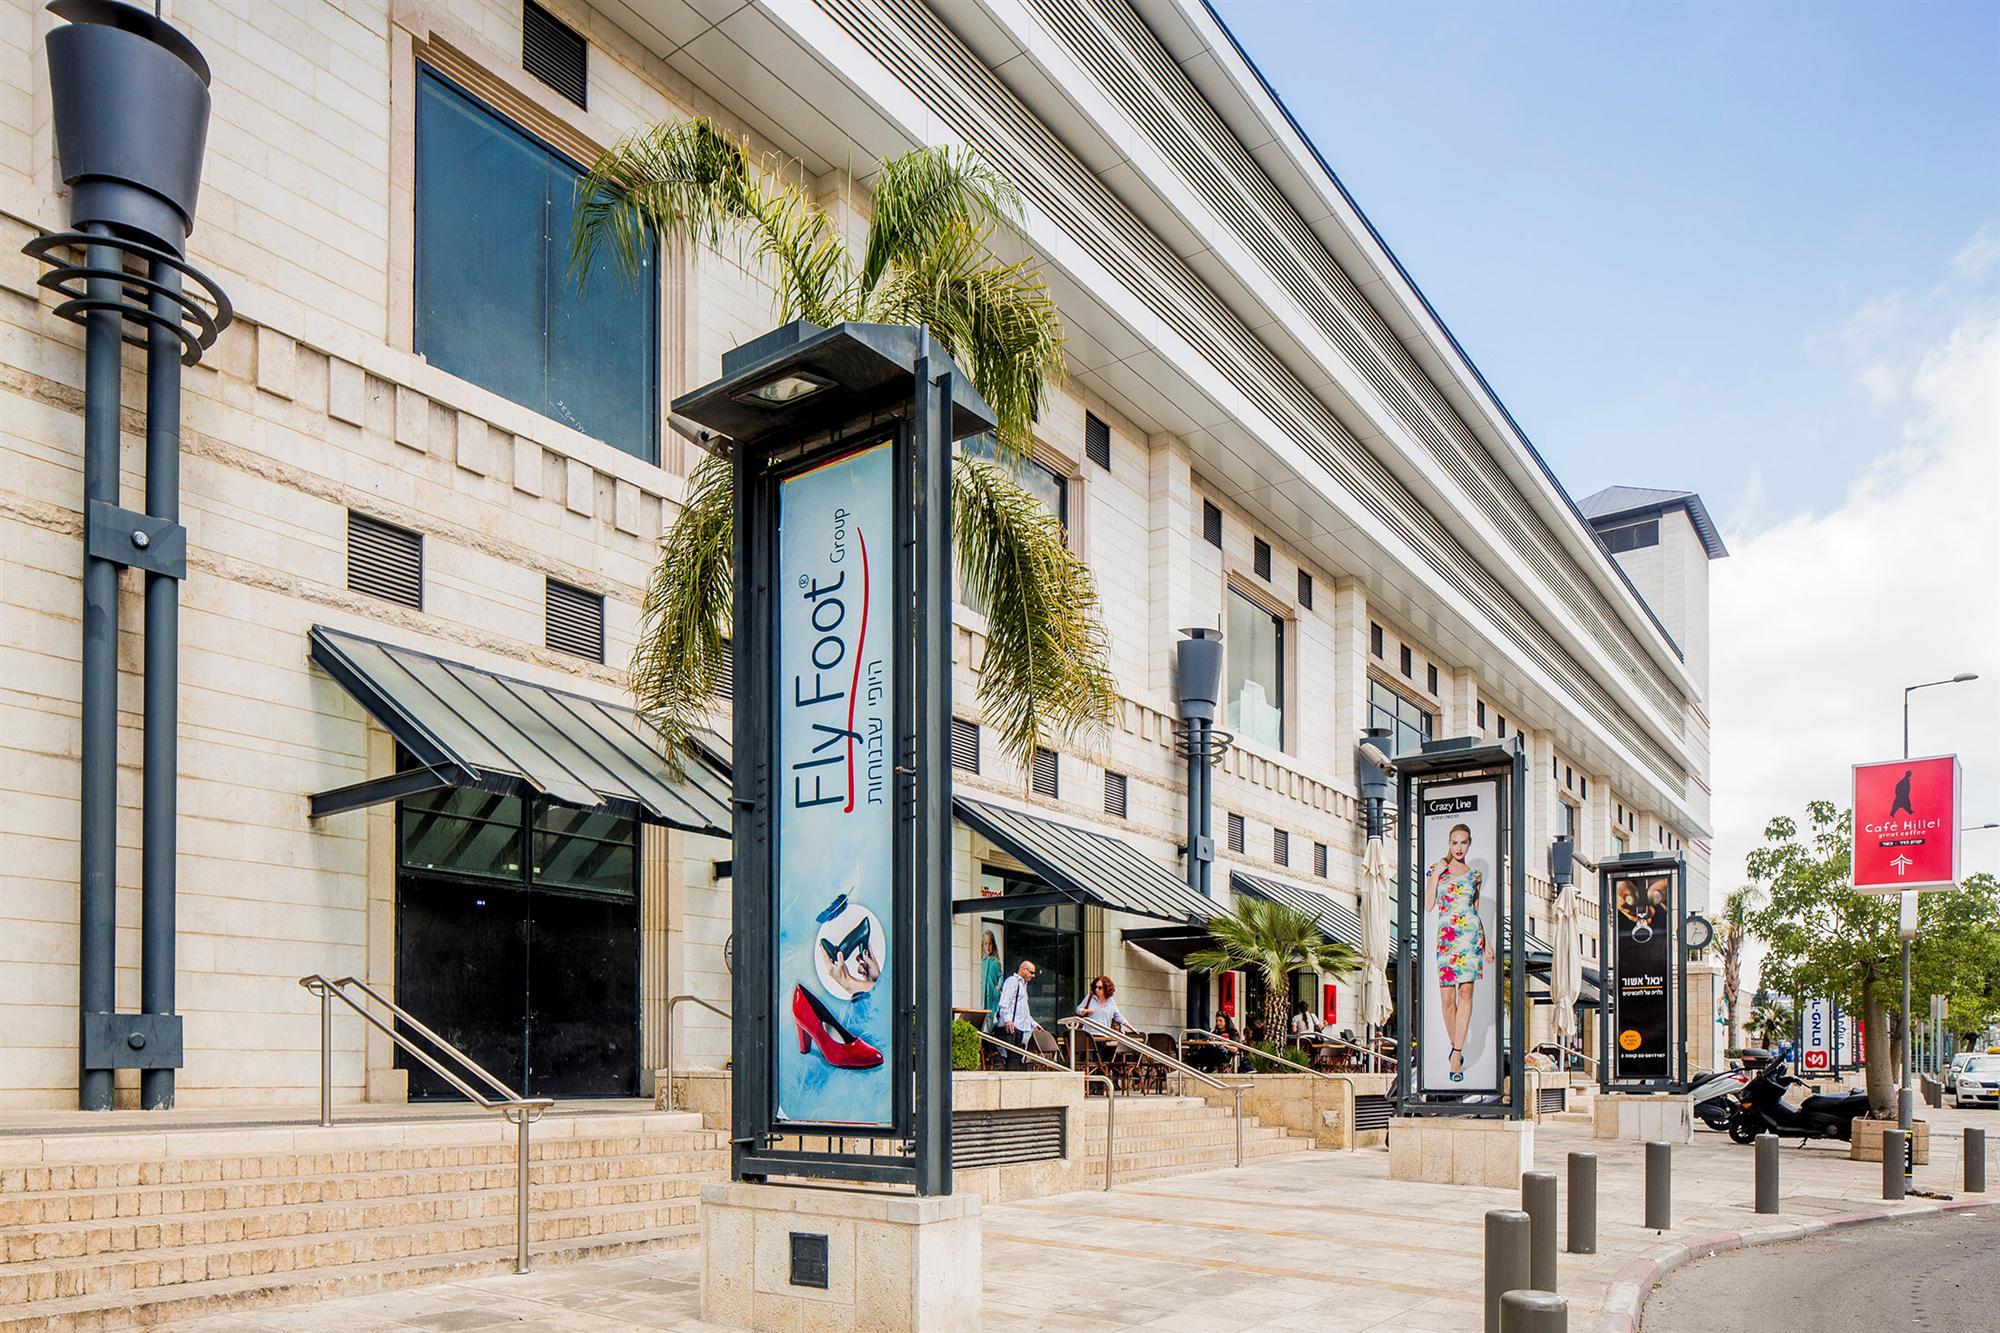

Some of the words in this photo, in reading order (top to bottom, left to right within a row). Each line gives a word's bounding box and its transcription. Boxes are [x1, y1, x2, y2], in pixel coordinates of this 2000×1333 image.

[792, 723, 863, 809] Fly
[829, 508, 850, 564] Group
[867, 660, 883, 707] היופי
[867, 717, 883, 805] שבנוחות
[1430, 800, 1454, 812] Crazy
[1456, 798, 1472, 810] Line
[1865, 821, 1898, 833] Café
[1903, 818, 1940, 830] Hillel
[1622, 977, 1644, 986] אשור
[1644, 974, 1663, 985] יגאל
